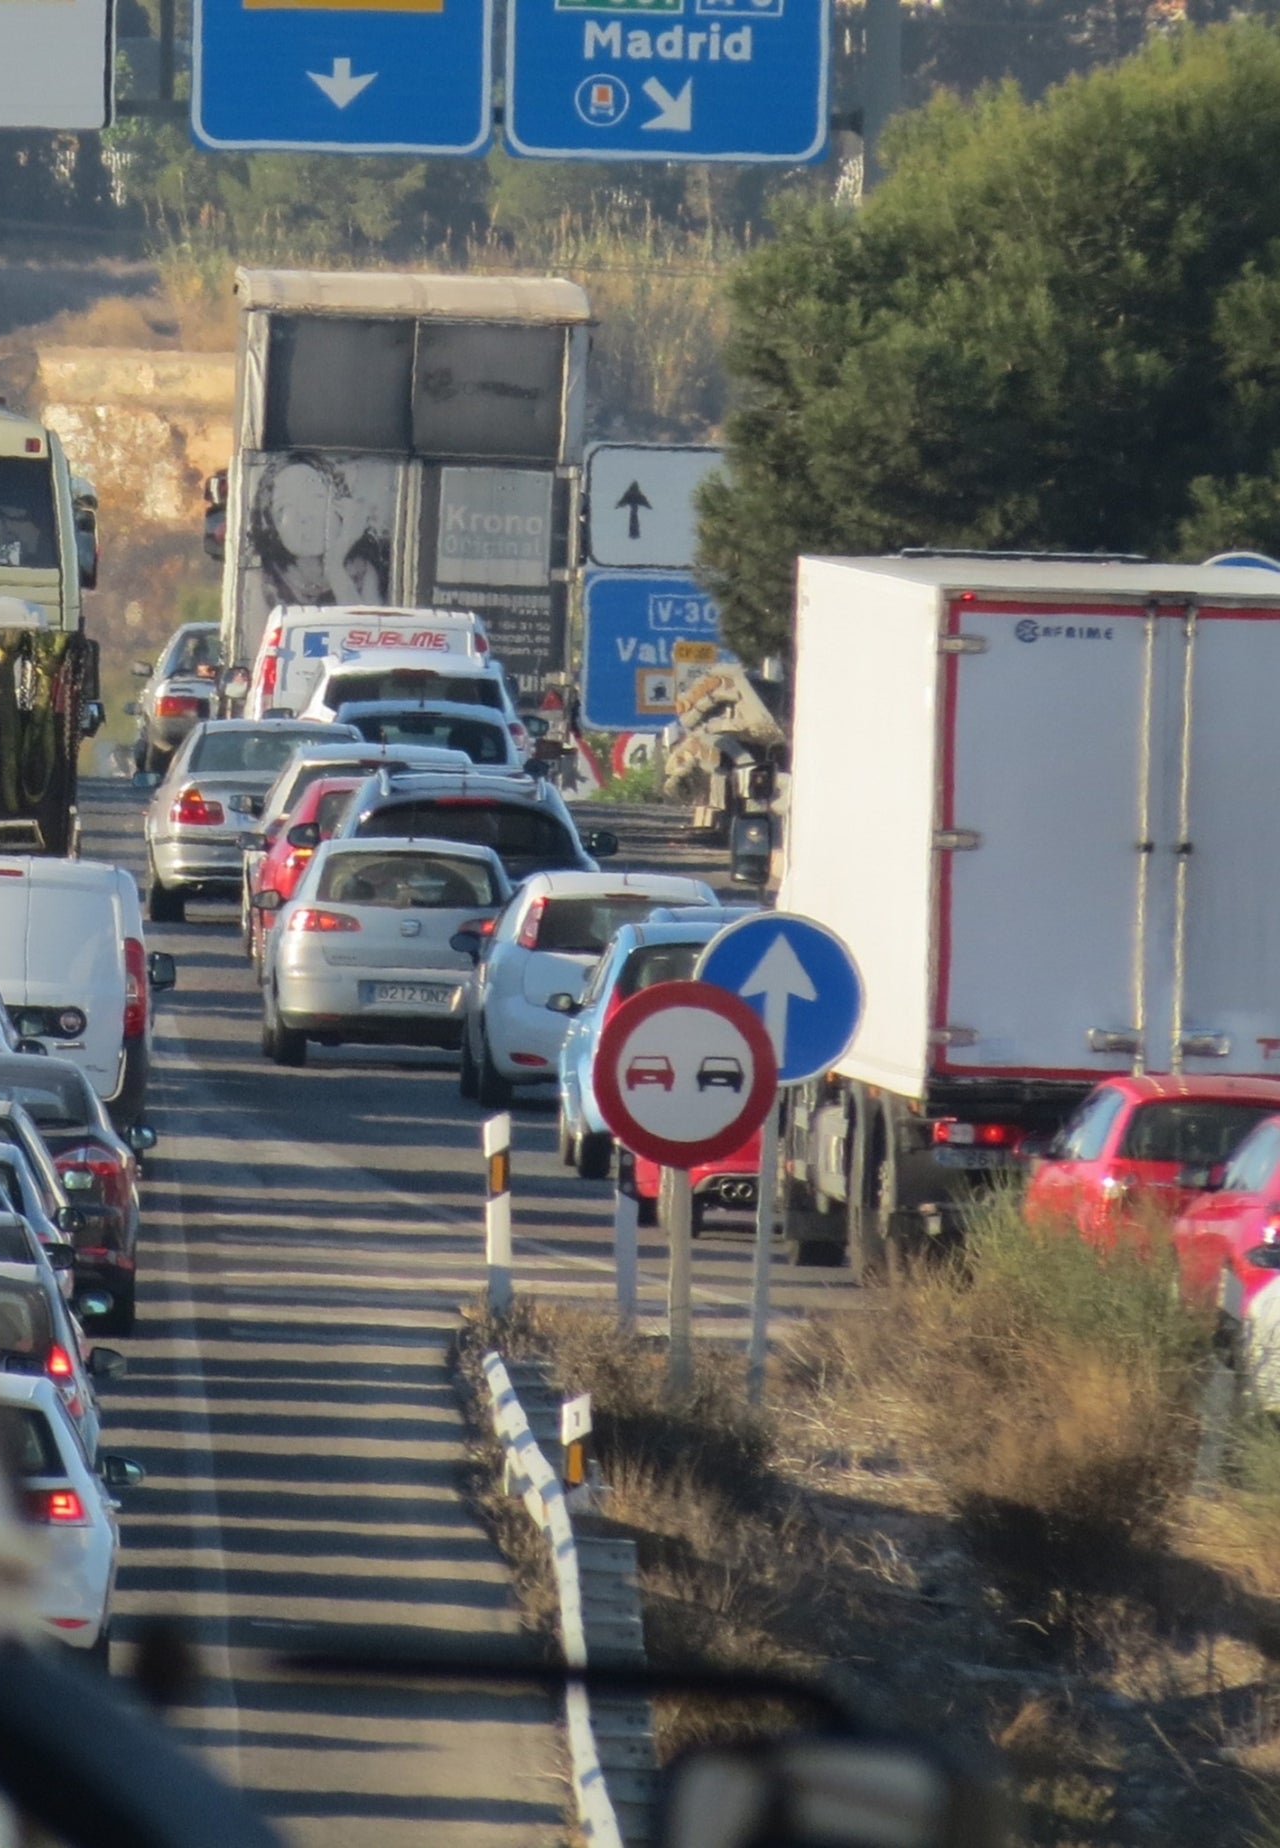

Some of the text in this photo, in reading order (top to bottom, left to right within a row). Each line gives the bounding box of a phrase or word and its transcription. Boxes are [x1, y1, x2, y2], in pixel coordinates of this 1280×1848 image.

[583, 20, 753, 61] Madrid
[446, 503, 544, 535] Krono
[658, 600, 721, 624] V-30
[346, 629, 448, 648] SUBLIME
